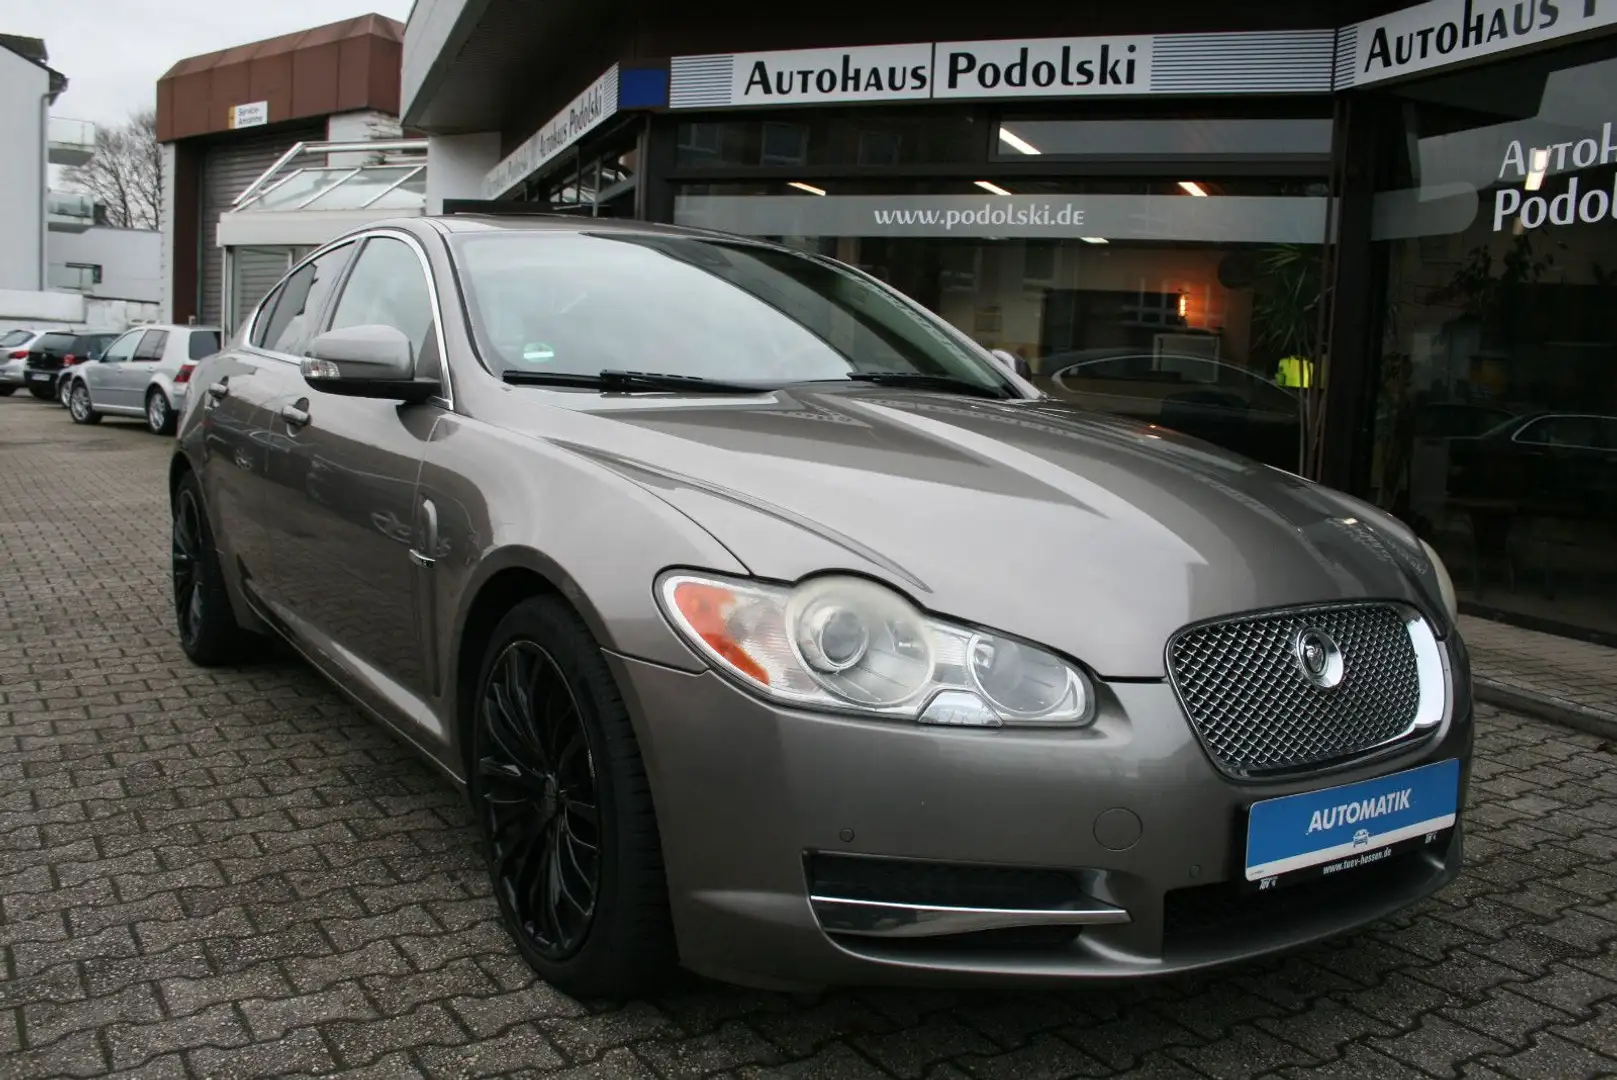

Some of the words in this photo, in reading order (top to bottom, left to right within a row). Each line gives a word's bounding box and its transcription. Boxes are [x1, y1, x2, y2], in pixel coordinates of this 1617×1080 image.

[948, 44, 1136, 89] Podolski
[873, 203, 1085, 230] www.podolski.de
[1308, 788, 1413, 833] AUTOMATIK
[1323, 847, 1392, 875] www.tuev-hessen.de
